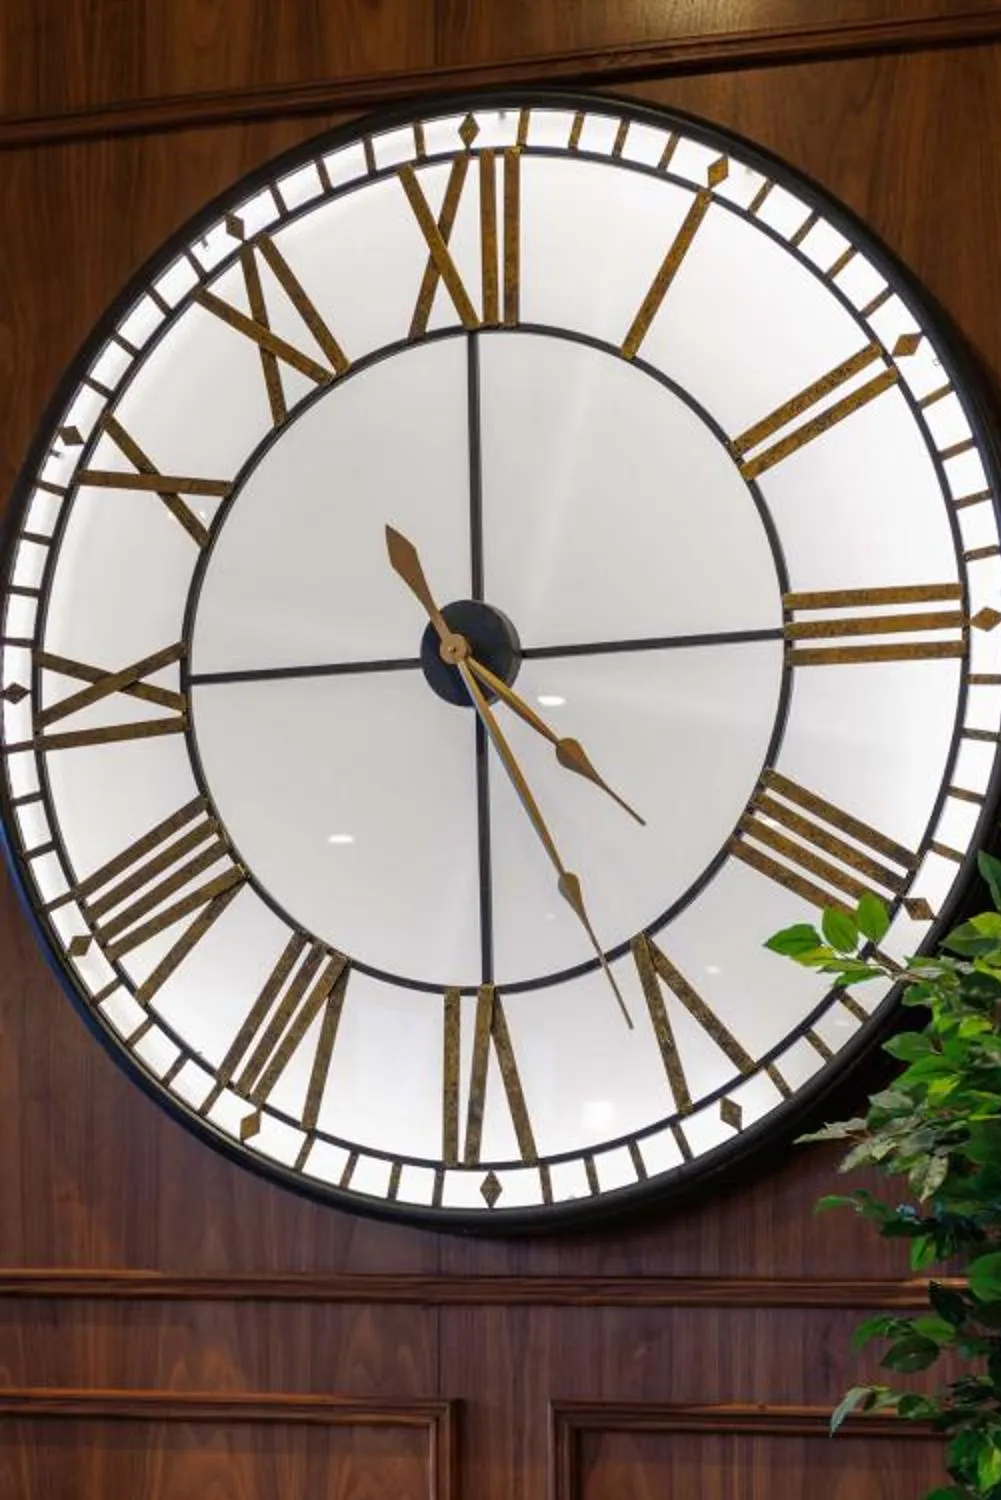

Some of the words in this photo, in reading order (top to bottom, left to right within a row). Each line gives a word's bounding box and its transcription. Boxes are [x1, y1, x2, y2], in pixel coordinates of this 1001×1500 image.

[192, 232, 352, 428] XI
[398, 148, 520, 340] XII
[619, 187, 713, 360] I
[74, 412, 234, 550] X
[728, 341, 902, 482] II
[34, 641, 190, 751] IX
[782, 582, 968, 668] III
[72, 795, 248, 1005] VIII
[215, 928, 351, 1133] VII
[444, 982, 538, 1168] VI
[633, 930, 758, 1116] V
